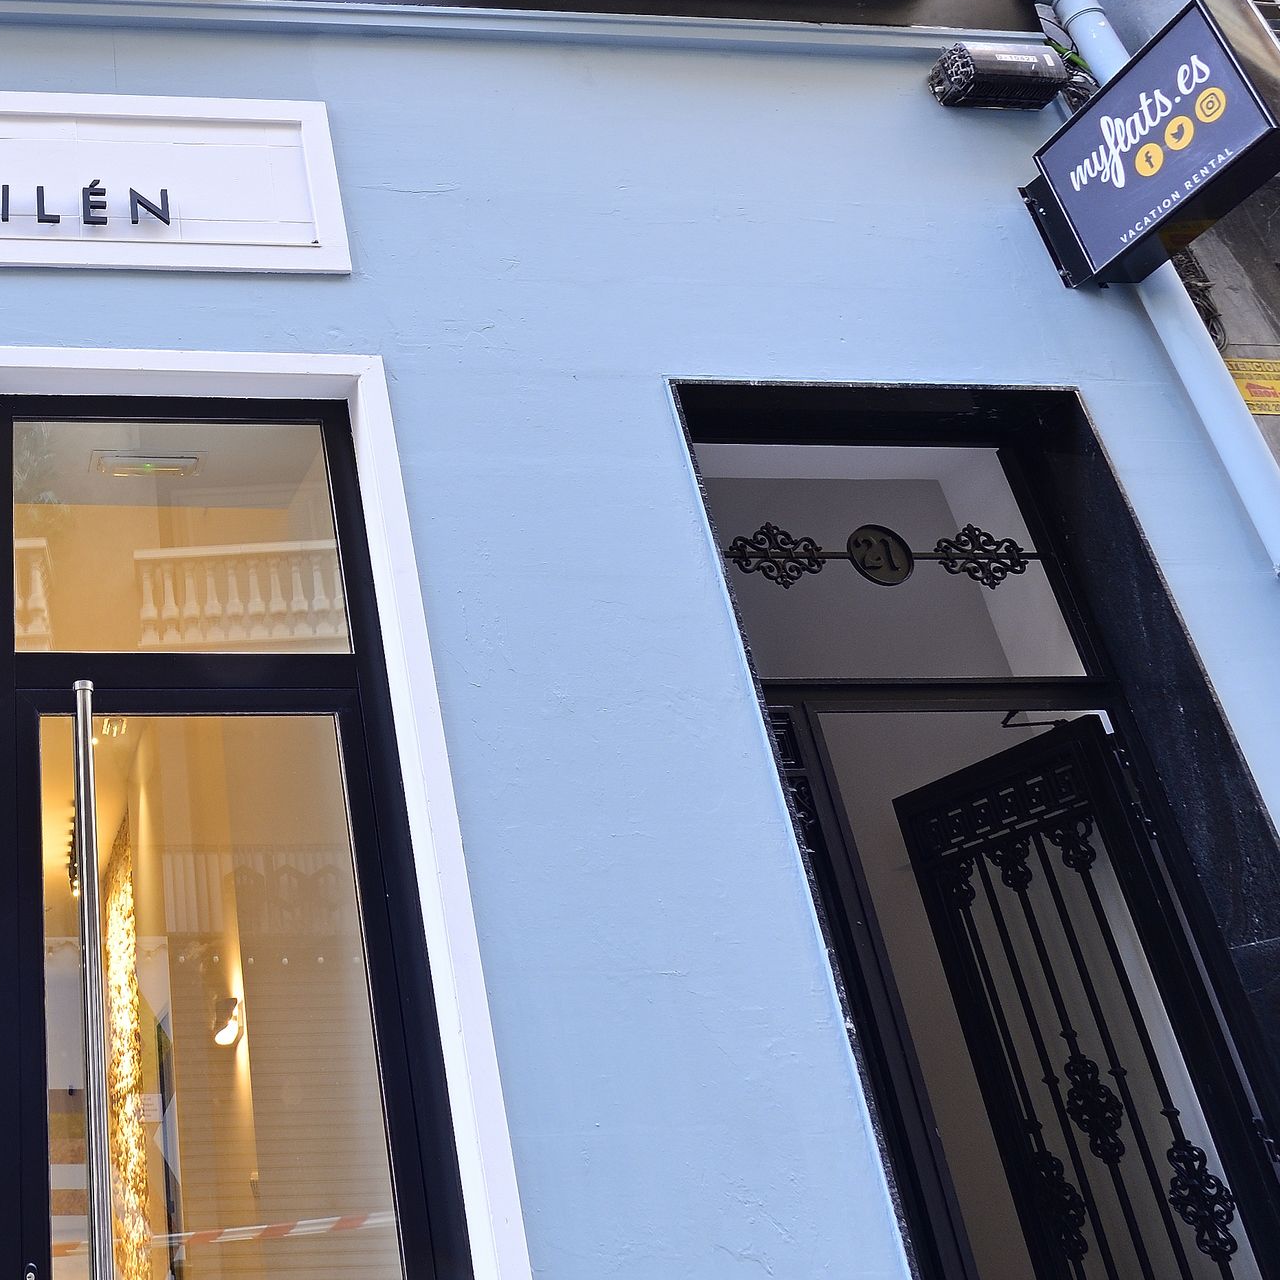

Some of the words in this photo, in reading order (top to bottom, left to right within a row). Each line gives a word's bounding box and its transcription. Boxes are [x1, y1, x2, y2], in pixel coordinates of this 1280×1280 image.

[1070, 54, 1211, 192] myflats.es
[1120, 190, 1181, 244] VACATION
[1184, 148, 1234, 190] RENTAL
[854, 536, 901, 572] 21
